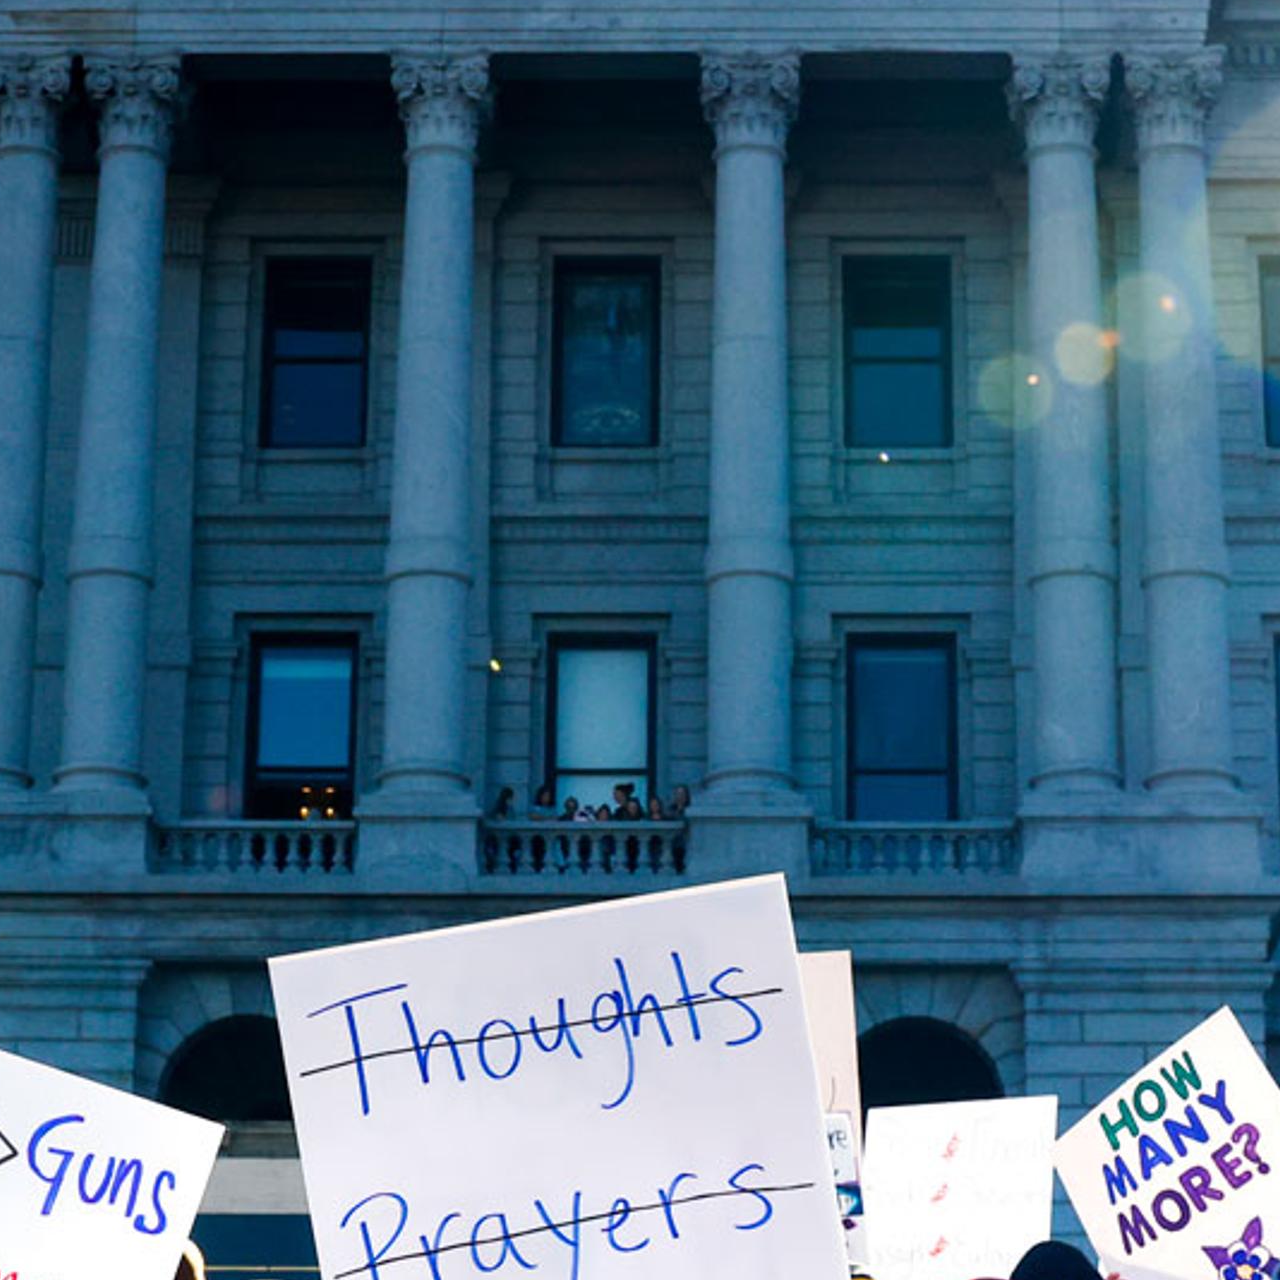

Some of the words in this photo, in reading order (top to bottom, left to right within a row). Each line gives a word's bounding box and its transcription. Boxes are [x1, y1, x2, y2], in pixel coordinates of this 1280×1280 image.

[307, 952, 782, 1115] Thoughts
[1099, 1050, 1202, 1152] HOW
[1102, 1079, 1235, 1206] MANY
[27, 1114, 176, 1235] Guns
[1118, 1123, 1270, 1256] MORE?
